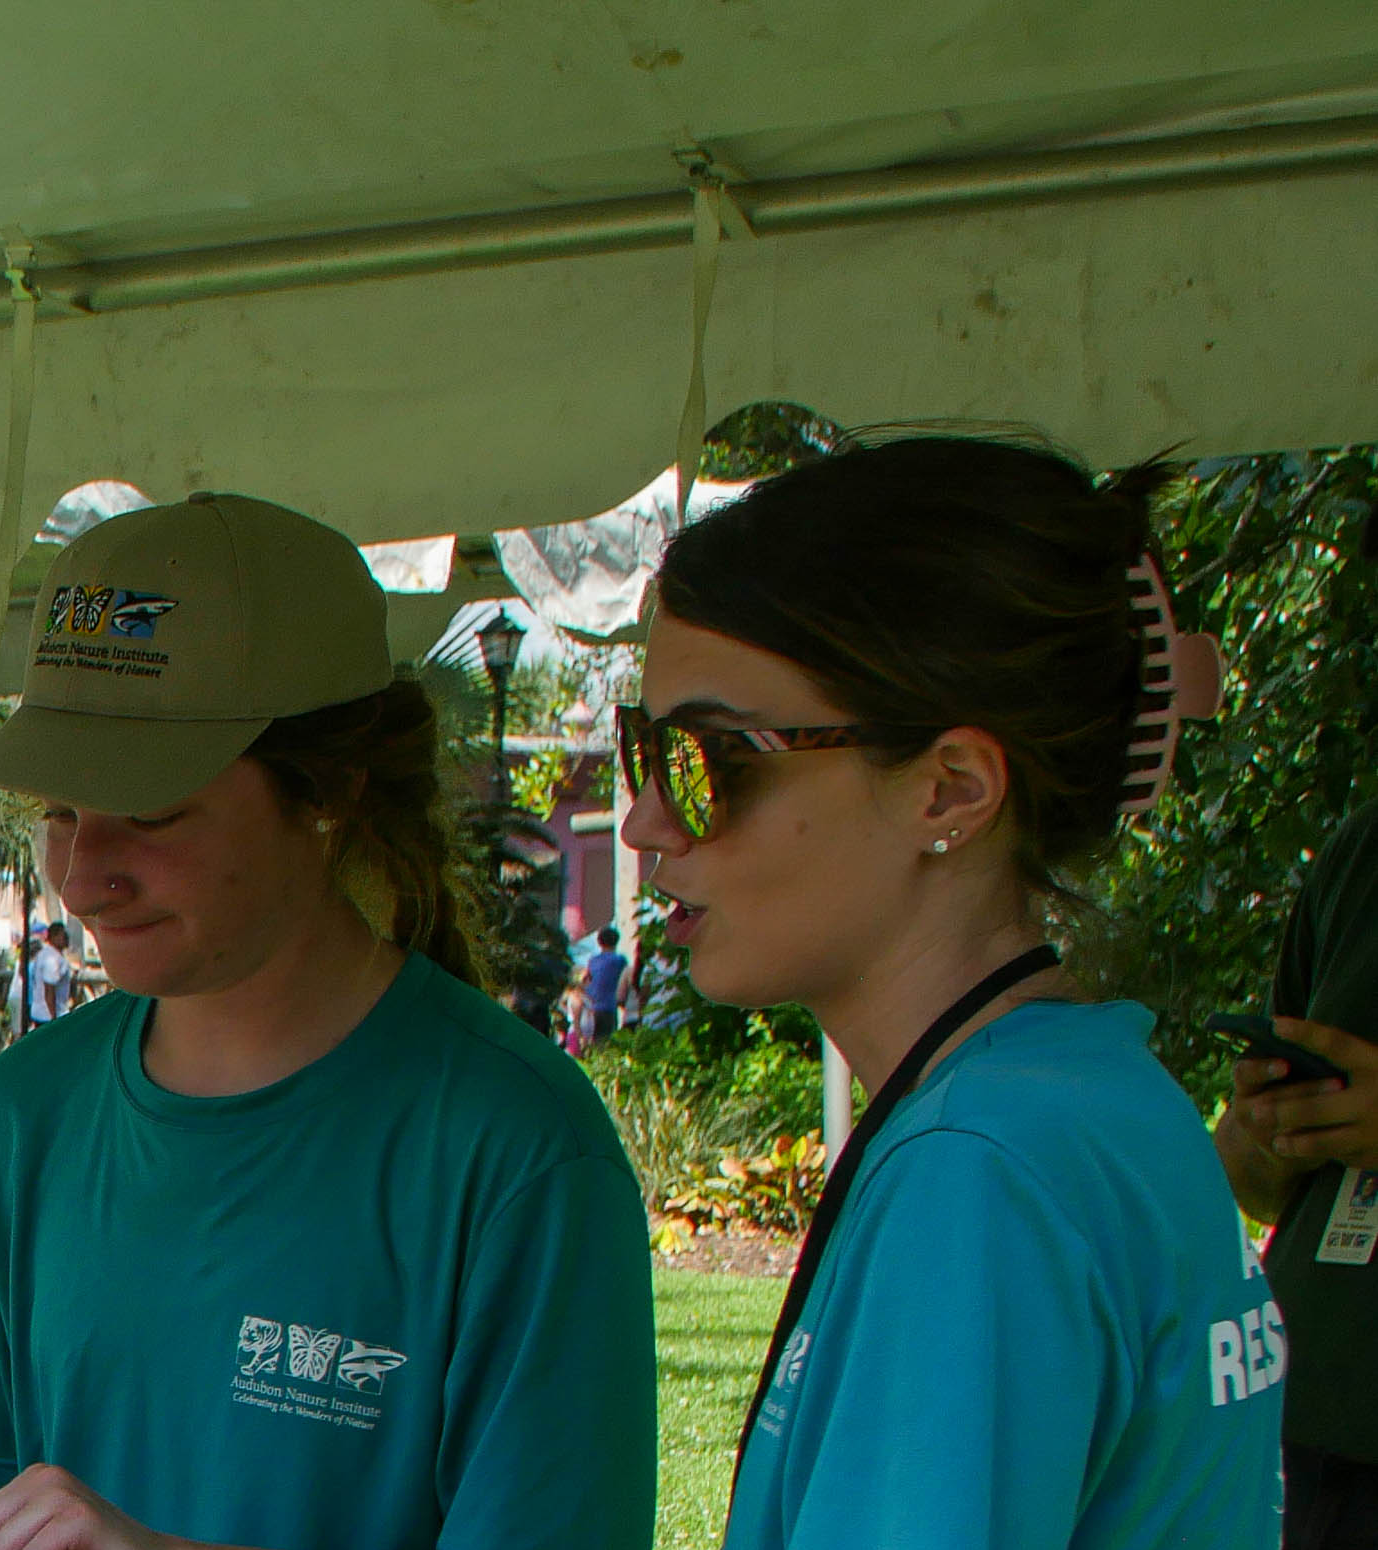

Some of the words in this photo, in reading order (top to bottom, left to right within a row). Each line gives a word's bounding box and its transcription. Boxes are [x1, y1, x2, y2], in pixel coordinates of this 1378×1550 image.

[230, 1375, 282, 1398] Audubon
[285, 1387, 328, 1407] Nature
[330, 1397, 381, 1418] Institute
